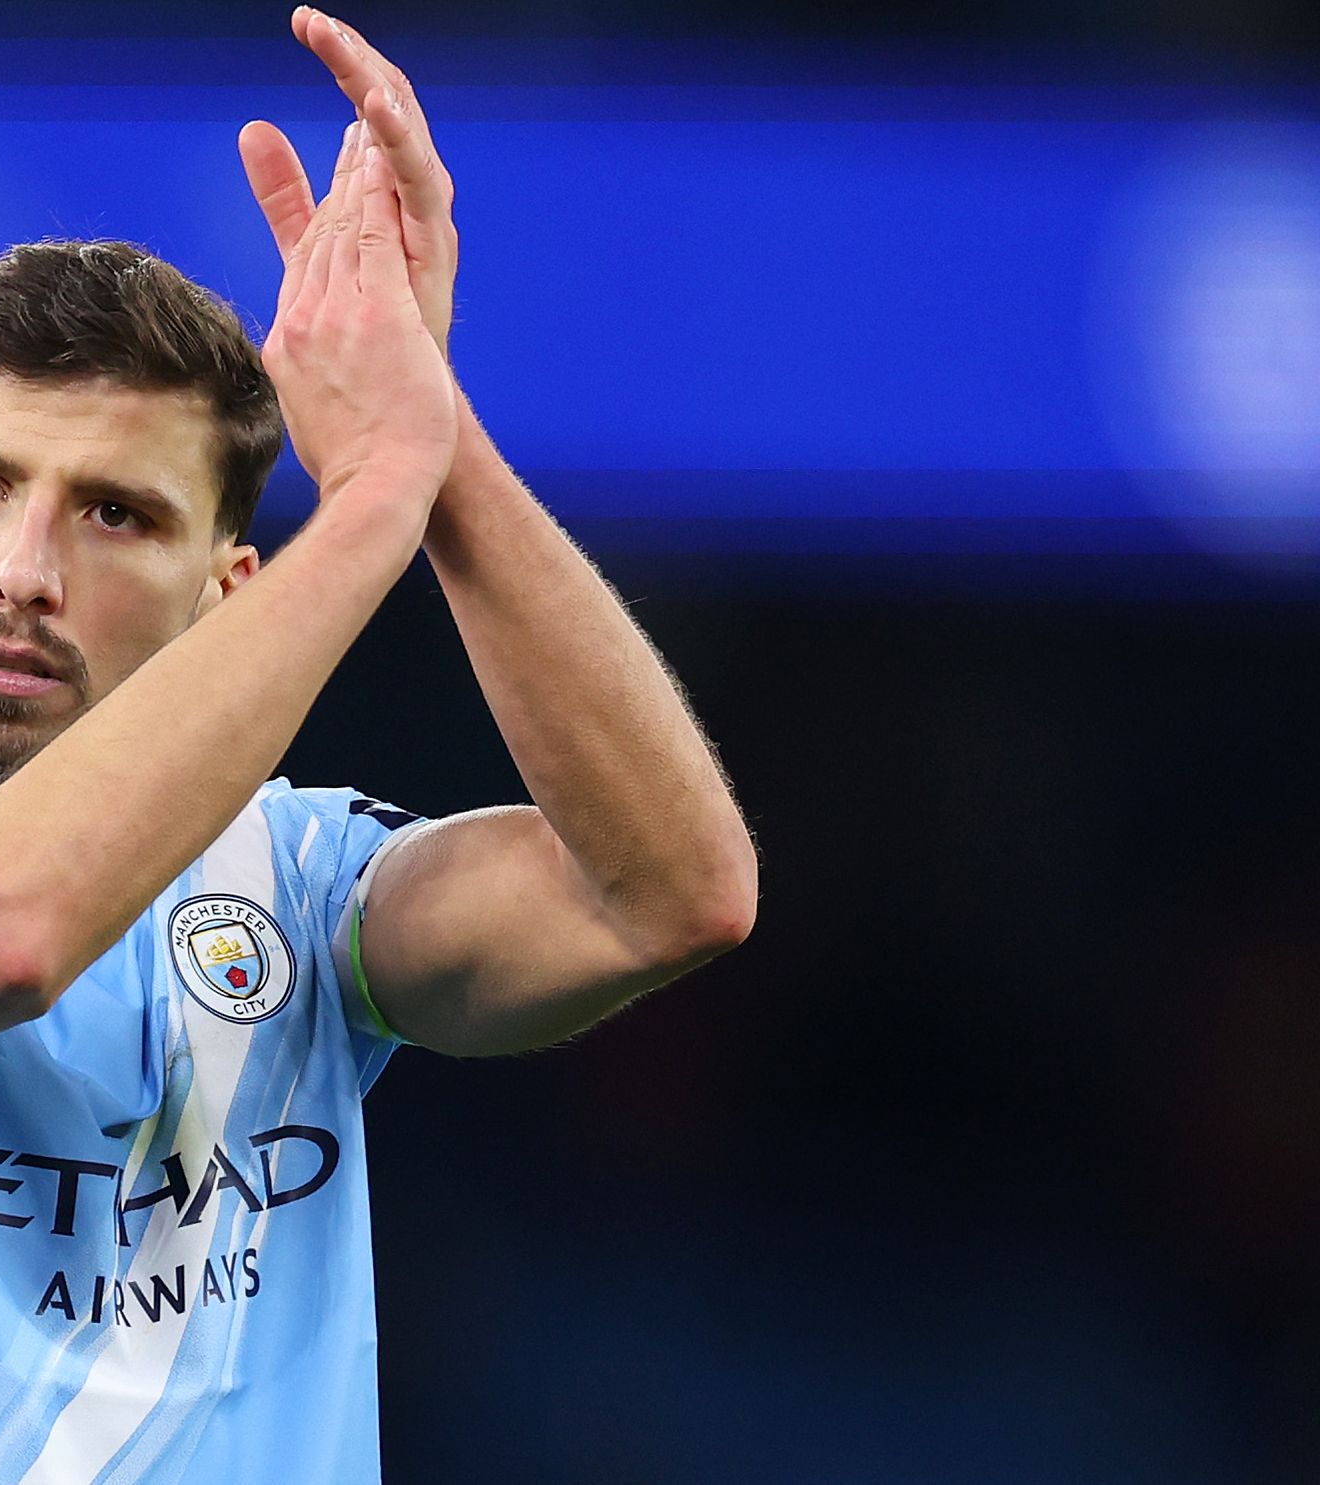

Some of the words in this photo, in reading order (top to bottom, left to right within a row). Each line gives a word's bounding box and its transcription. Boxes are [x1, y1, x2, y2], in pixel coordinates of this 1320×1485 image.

[176, 904, 267, 949] MANCHESTER
[233, 998, 267, 1015] CITY
[35, 1248, 260, 1327] AIRWAYS
